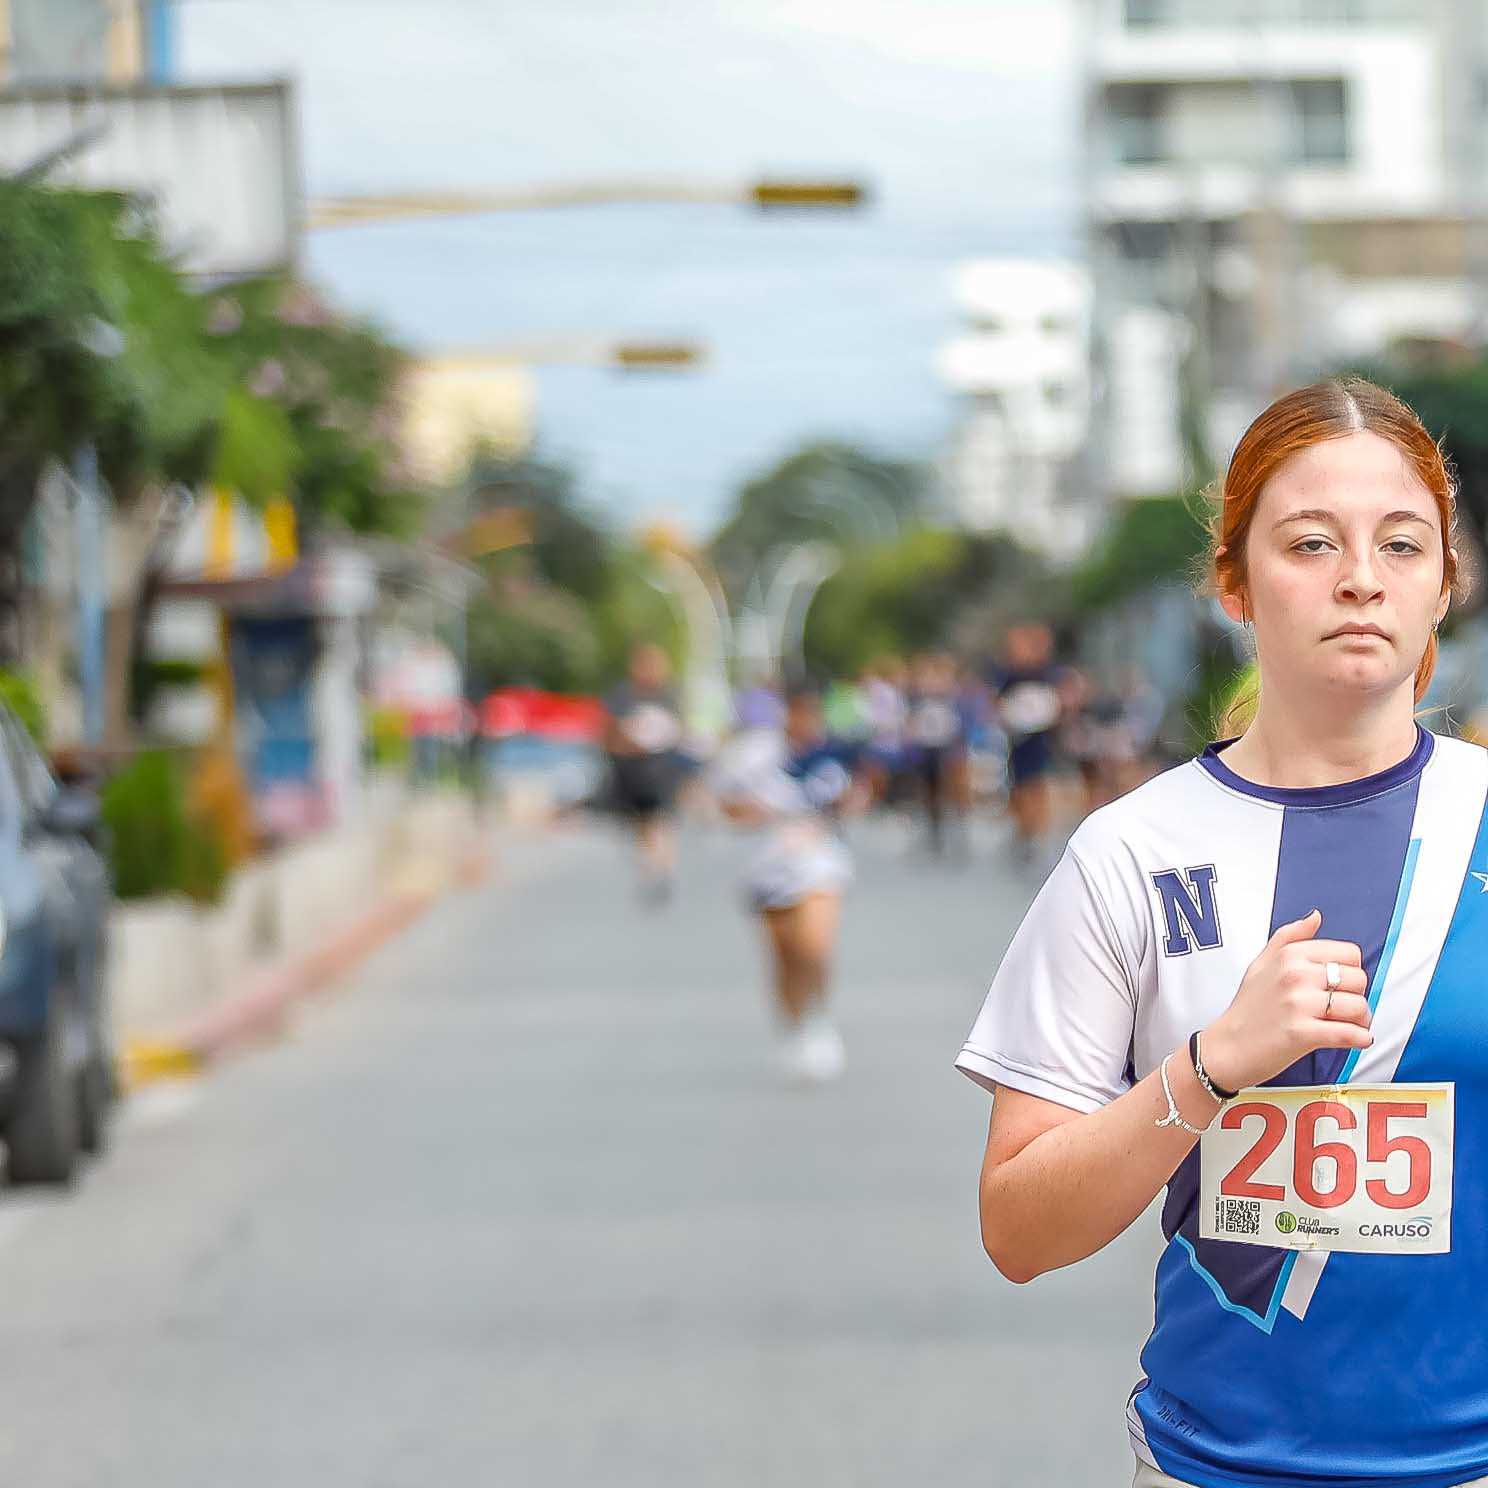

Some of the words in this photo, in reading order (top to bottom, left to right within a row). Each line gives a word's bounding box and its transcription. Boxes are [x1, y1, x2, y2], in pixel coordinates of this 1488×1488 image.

[1149, 864, 1223, 957] N
[1221, 1100, 1432, 1210] 265
[1298, 1216, 1320, 1226] CLUB
[1297, 1225, 1340, 1235] RUNNER'S
[1359, 1224, 1431, 1237] CARUSO
